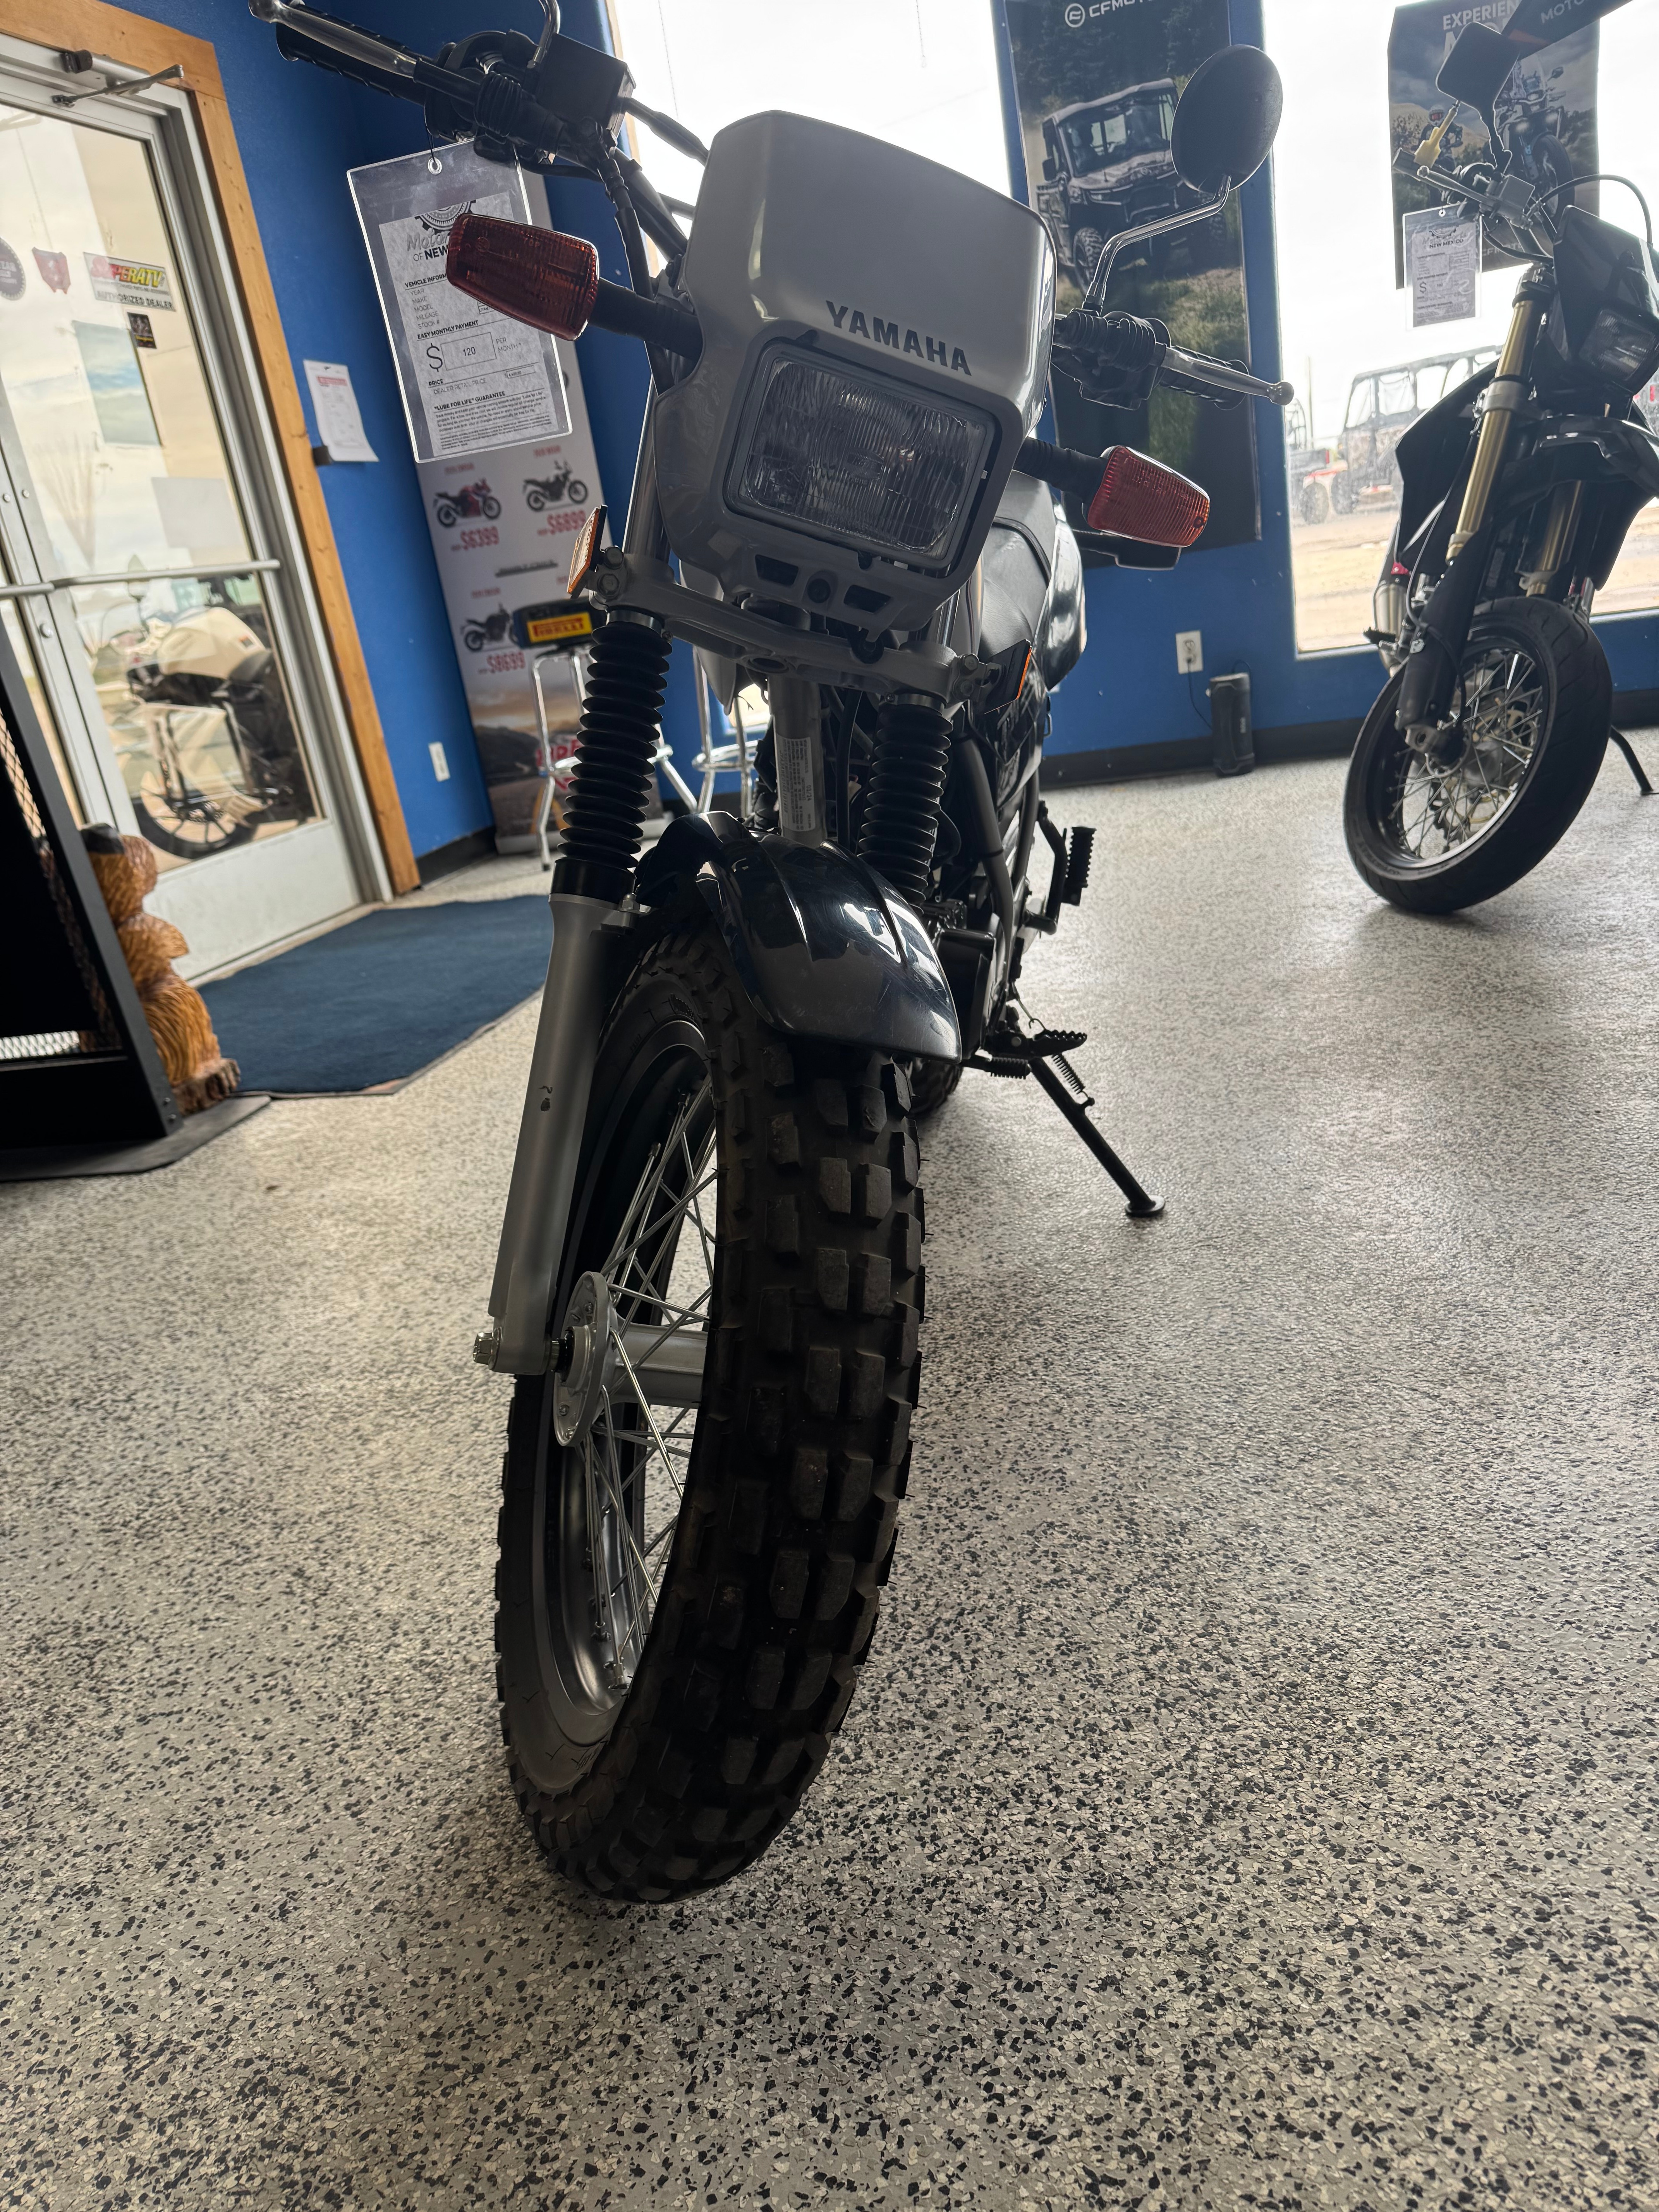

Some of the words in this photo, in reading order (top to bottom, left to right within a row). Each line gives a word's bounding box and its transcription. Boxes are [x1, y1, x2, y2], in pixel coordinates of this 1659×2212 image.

[1089, 0, 1152, 17] CFM
[1443, 0, 1521, 30] EXPERIEN
[407, 227, 450, 251] Motor
[413, 252, 424, 261] OF
[424, 245, 448, 260] NEW
[405, 278, 427, 287] VEHICLE
[428, 273, 447, 282] INFORM
[146, 297, 173, 309] DEALER
[414, 304, 433, 313] MODEL
[416, 311, 439, 321] MILEAGE
[418, 321, 435, 329] STOCK
[431, 326, 454, 336] MONTHLY
[455, 320, 479, 330] PAYMENT
[826, 300, 972, 376] YAMAHA
[426, 343, 443, 372] $
[463, 347, 476, 356] 120
[434, 386, 455, 394] DEALER
[472, 378, 486, 386] PRICE
[475, 391, 506, 402] GUARANTEE
